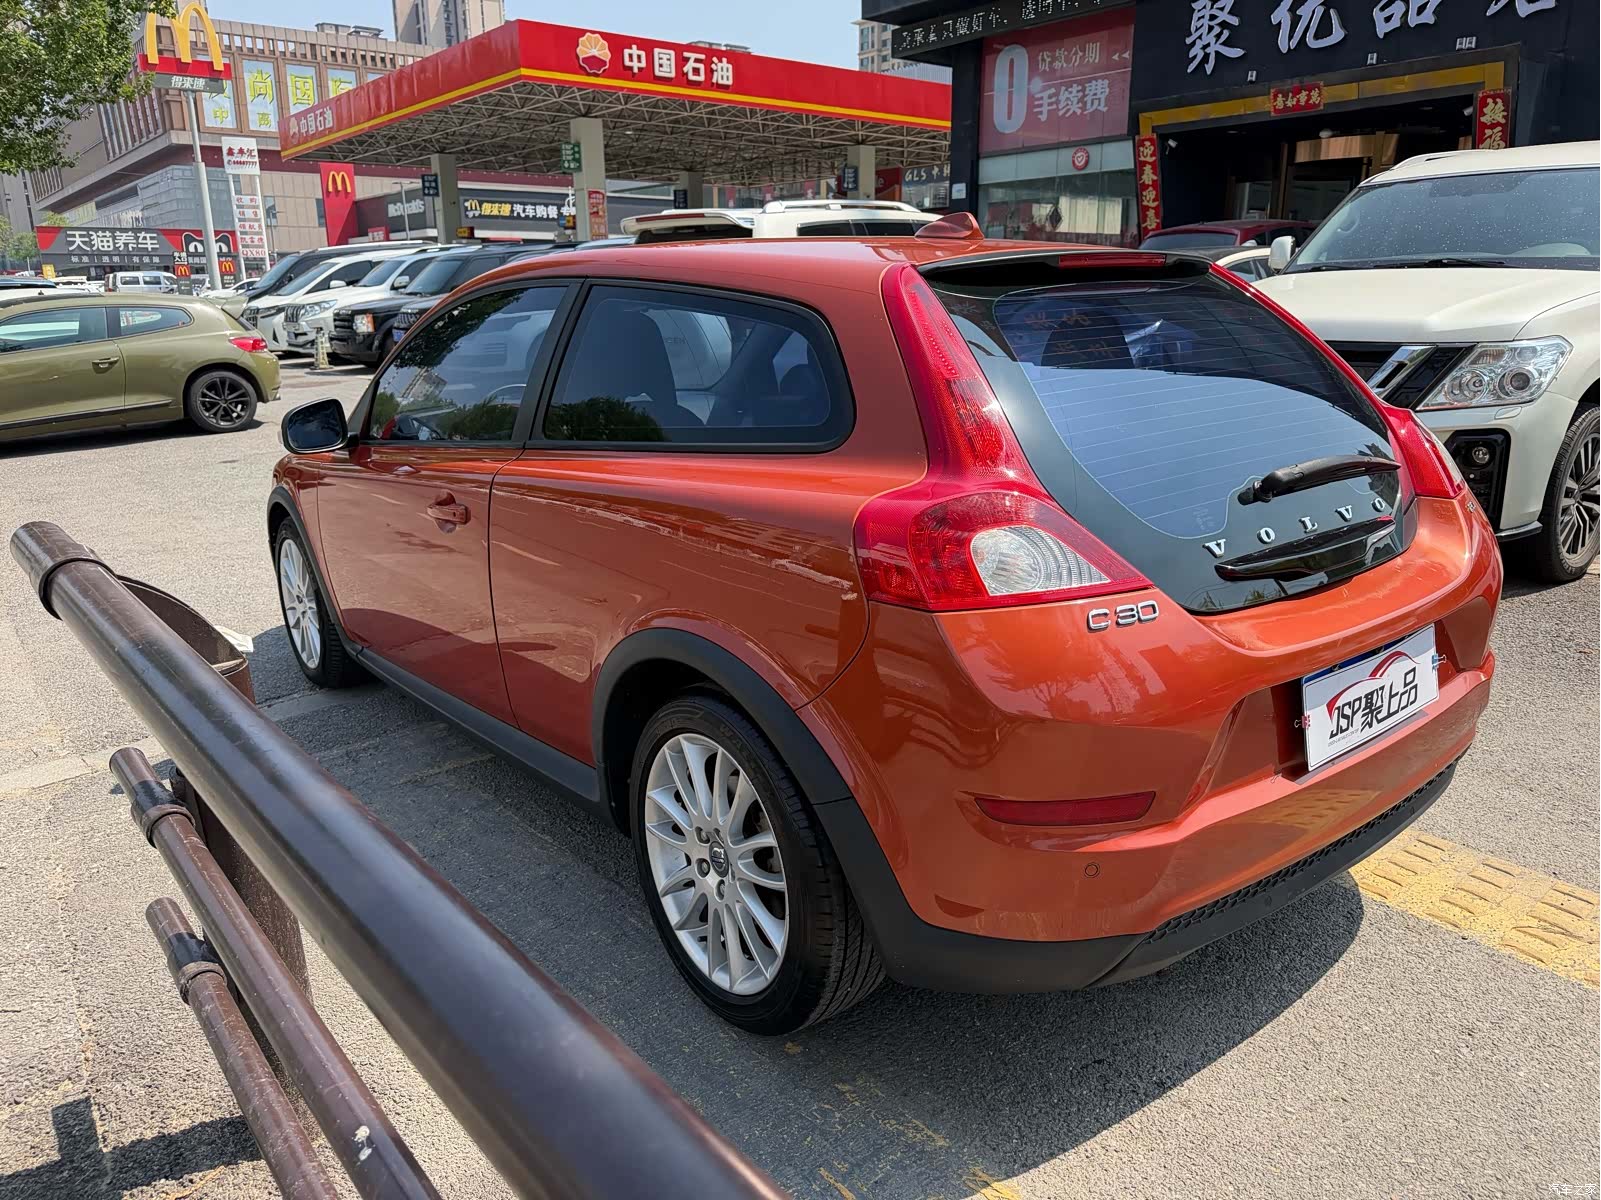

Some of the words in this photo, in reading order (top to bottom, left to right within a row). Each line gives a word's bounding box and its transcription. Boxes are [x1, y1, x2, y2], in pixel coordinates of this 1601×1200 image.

[1185, 0, 1556, 75] 聚优品
[623, 44, 733, 86] 中国石油
[1037, 42, 1101, 72] 贷款分期
[170, 75, 206, 89] 得来速
[1032, 79, 1110, 122] 手续费
[299, 106, 333, 137] 中国石油
[905, 168, 927, 181] GLS
[513, 203, 558, 218] 汽车购餐
[66, 230, 160, 251] 天猫养车
[241, 248, 266, 257] QX80
[1203, 496, 1386, 558] VOLVO
[1086, 600, 1159, 630] C30
